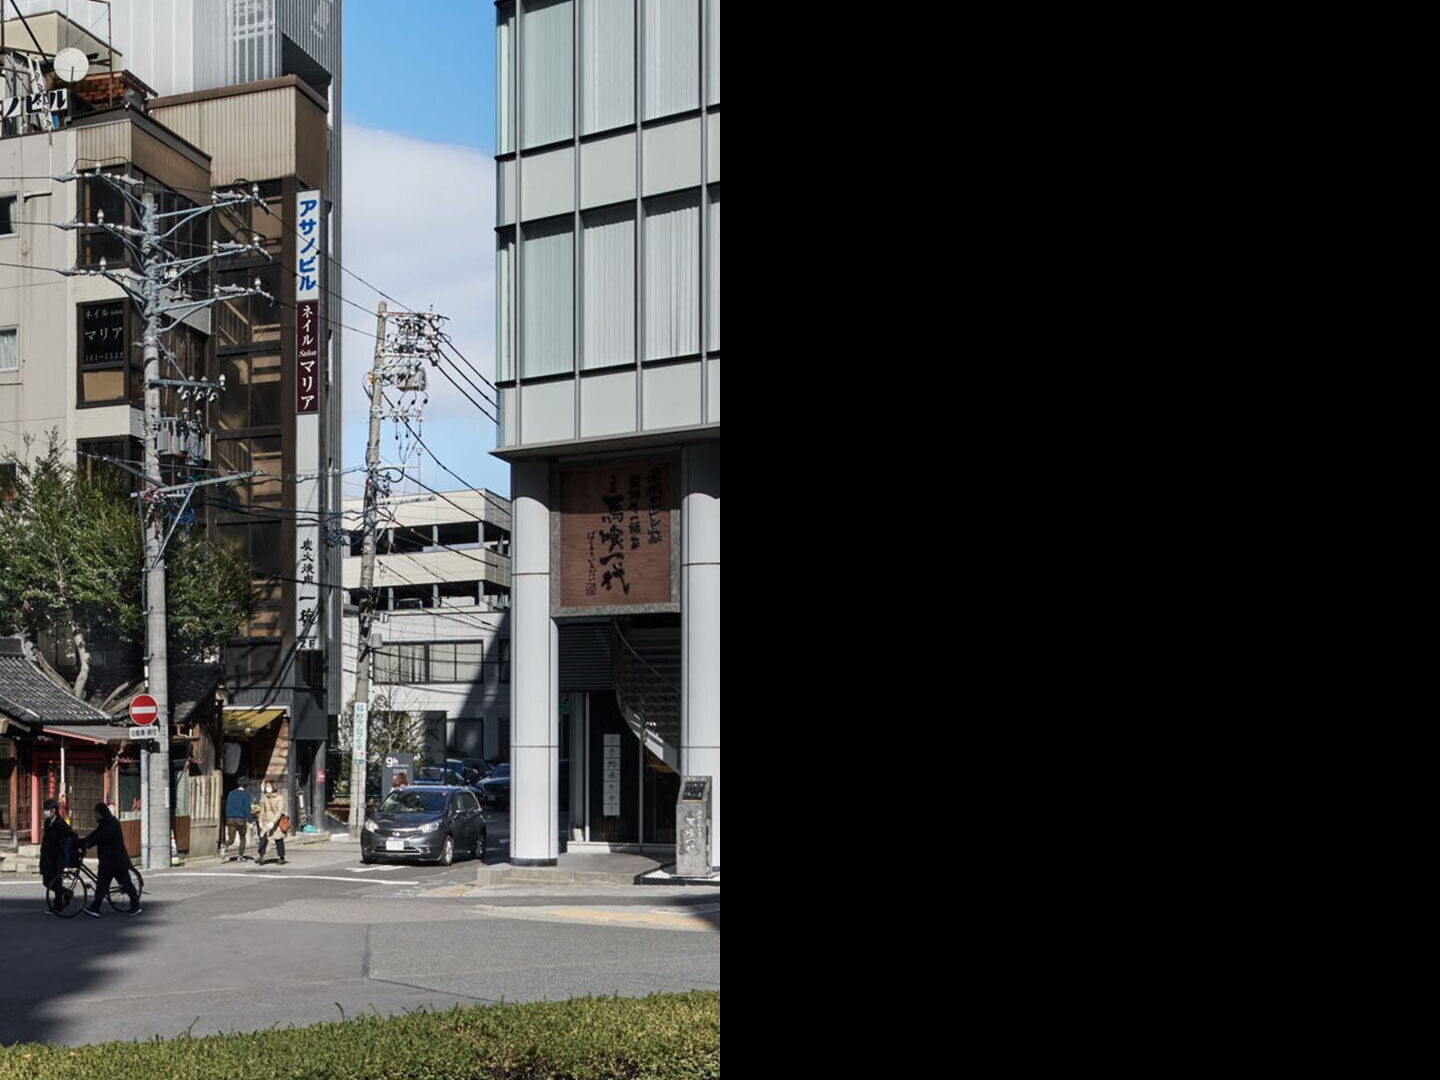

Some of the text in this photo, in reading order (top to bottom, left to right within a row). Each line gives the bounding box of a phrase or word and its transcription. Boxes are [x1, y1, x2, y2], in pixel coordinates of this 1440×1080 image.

[299, 199, 317, 291] アサノビル
[84, 327, 123, 341] マリア
[301, 305, 314, 347] ネイル
[300, 360, 315, 410] マリア
[300, 639, 316, 648] 2F
